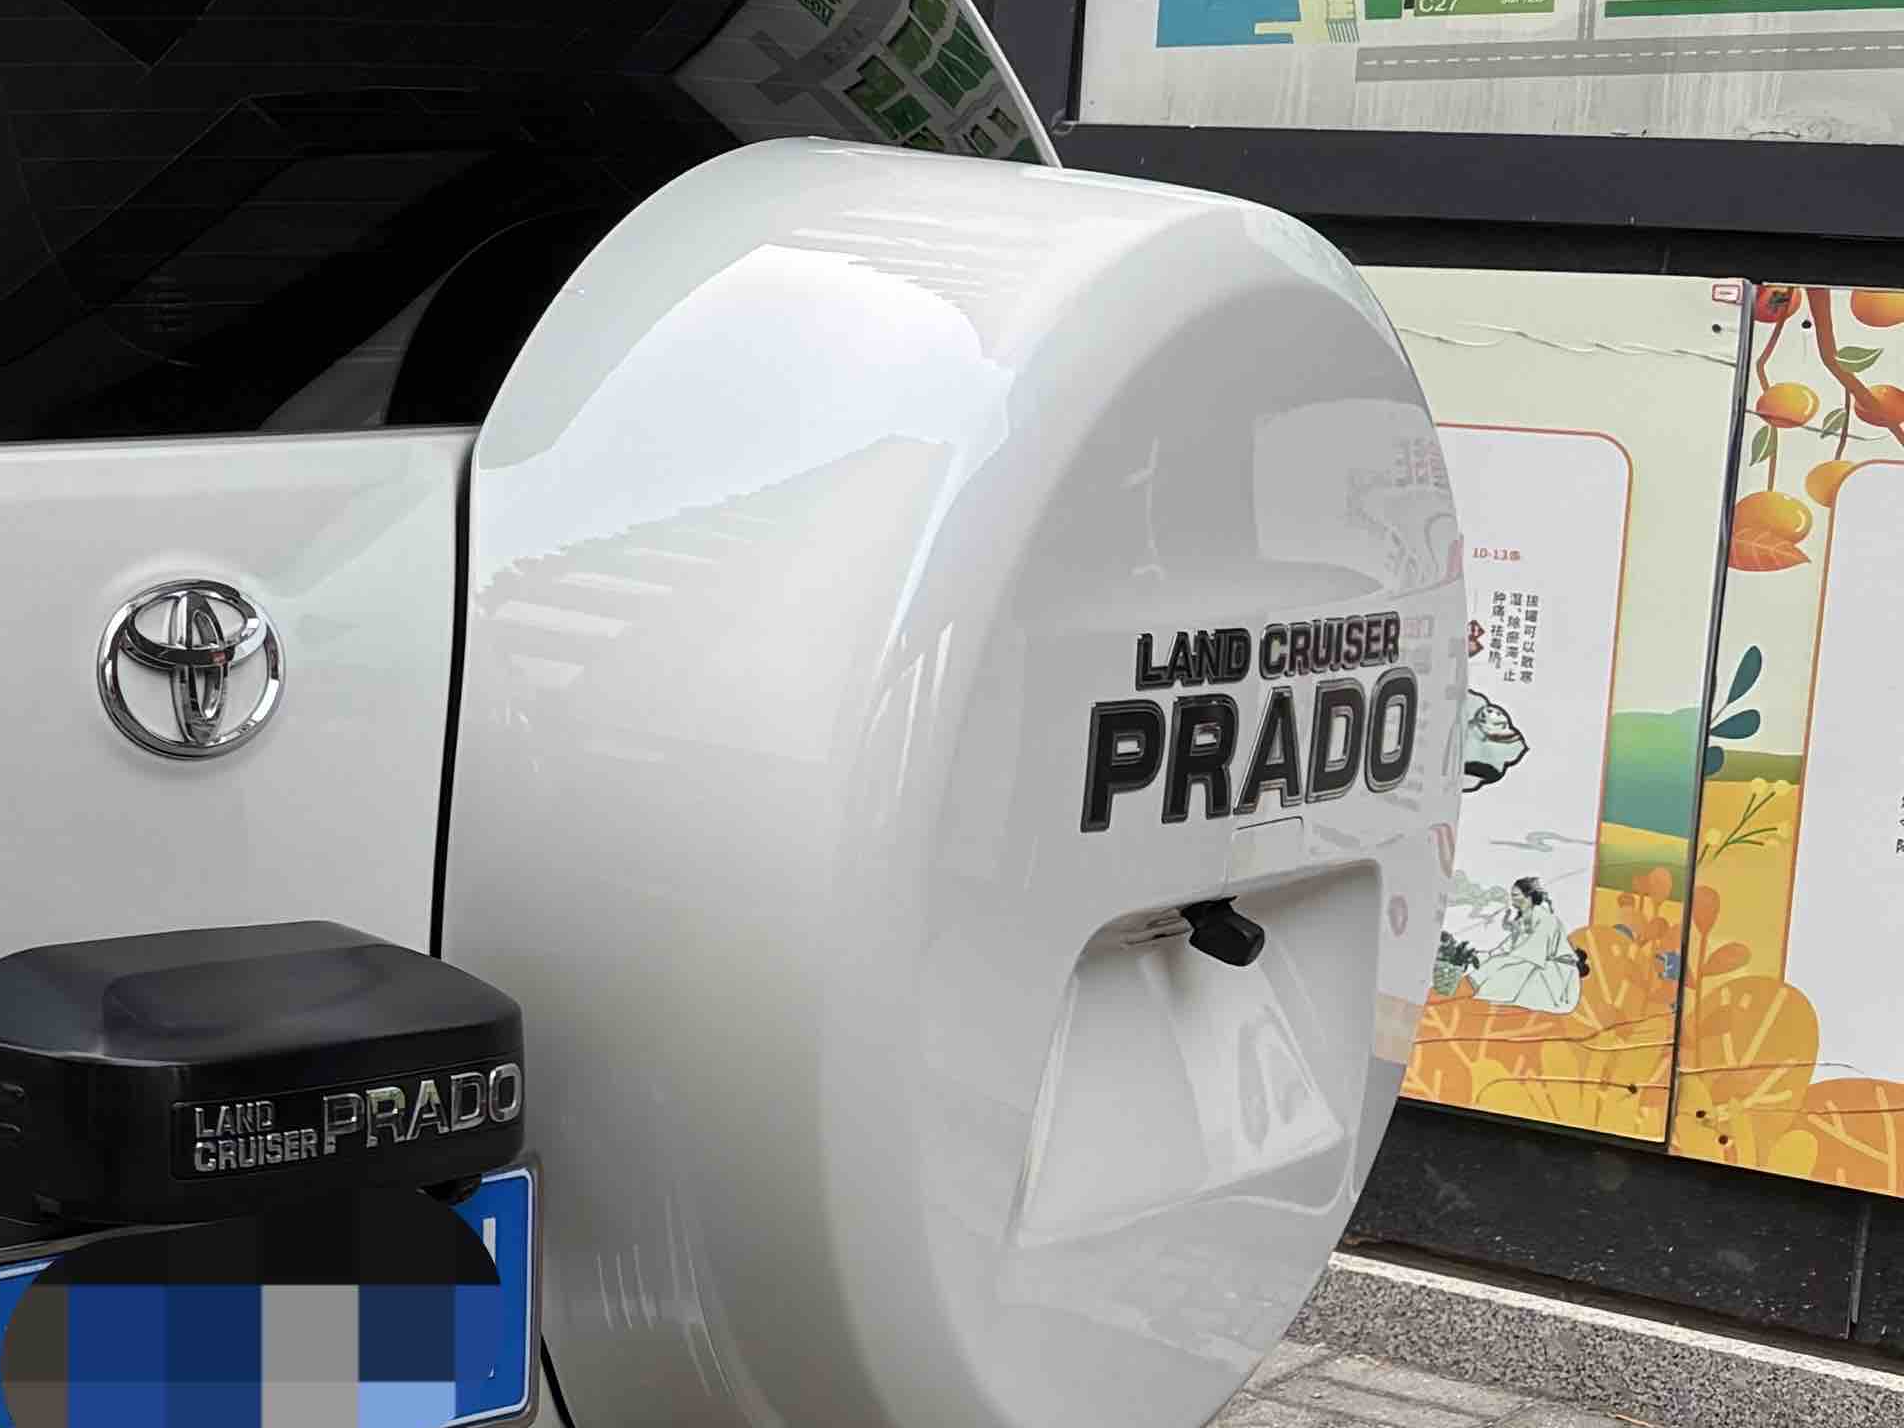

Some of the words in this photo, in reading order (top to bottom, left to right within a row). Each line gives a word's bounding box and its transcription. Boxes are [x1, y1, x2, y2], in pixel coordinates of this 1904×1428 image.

[1135, 627, 1252, 691] LAND
[1259, 610, 1401, 681] CRUISER
[1080, 666, 1418, 834] PRADO
[194, 1099, 276, 1139] LAND
[321, 1062, 523, 1156] PRADO
[193, 1128, 320, 1174] CRUISER
